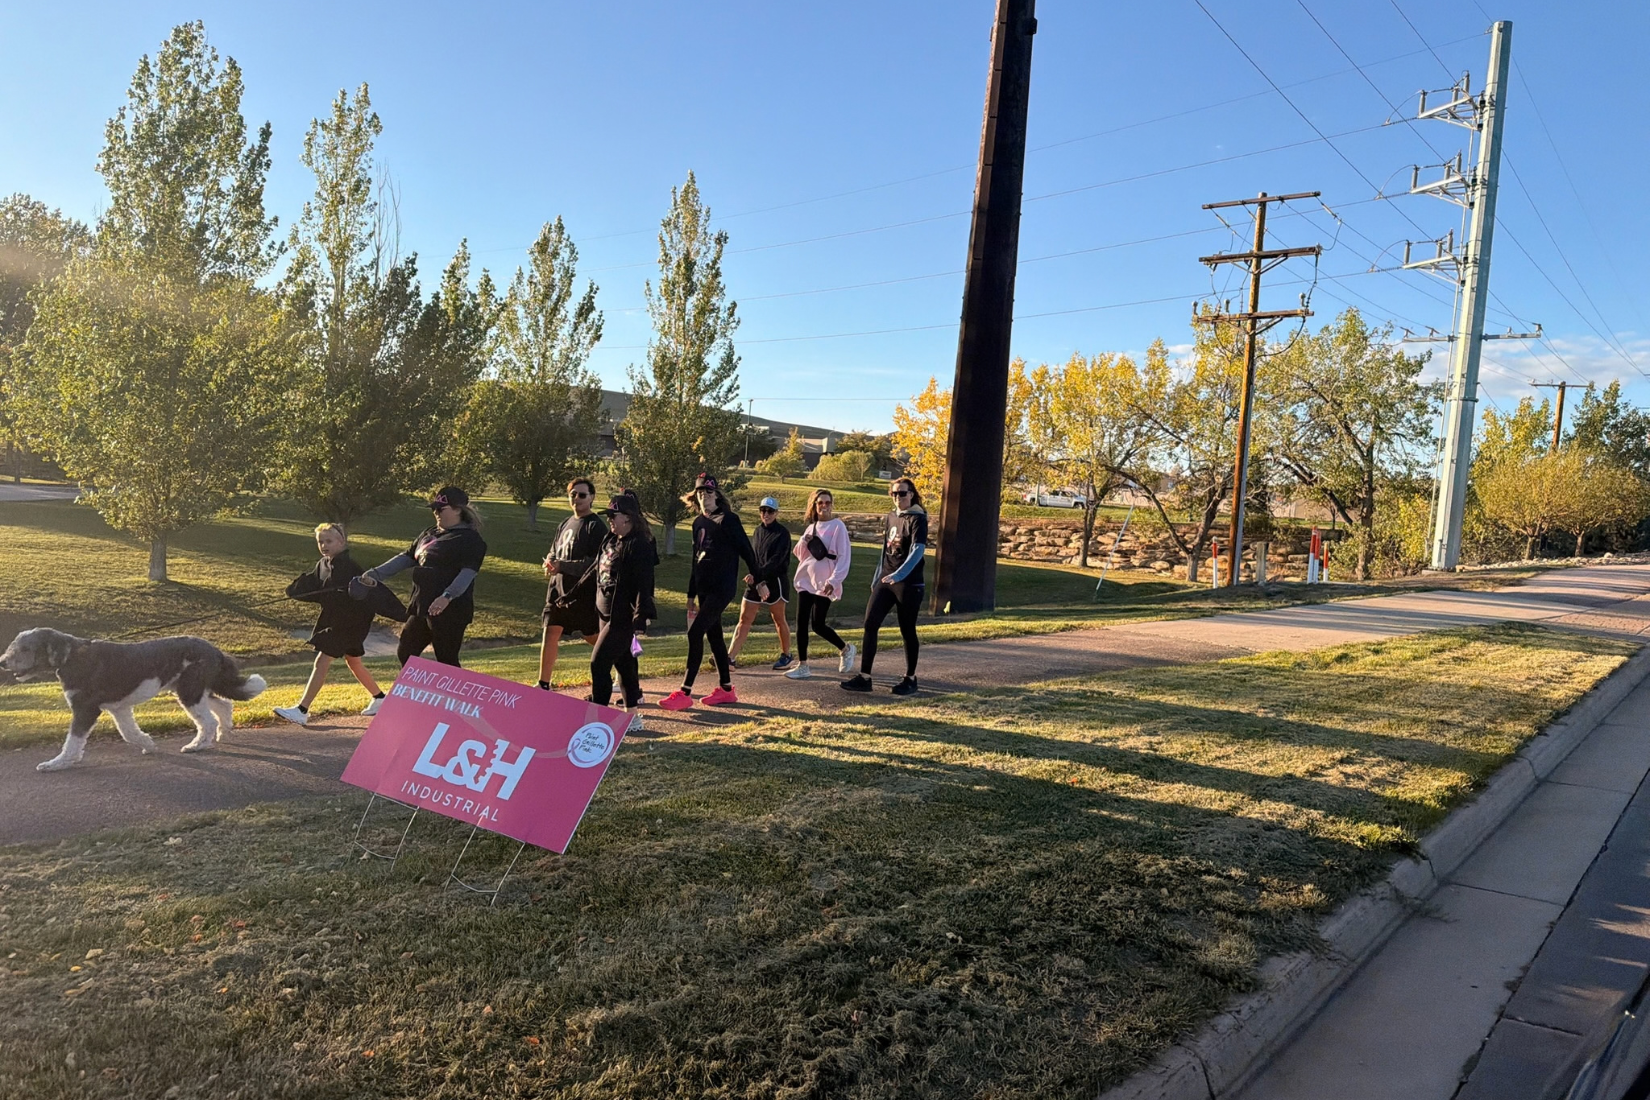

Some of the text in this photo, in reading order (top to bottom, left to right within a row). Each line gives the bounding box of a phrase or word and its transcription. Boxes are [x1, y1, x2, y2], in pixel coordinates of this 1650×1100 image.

[391, 683, 484, 719] BENEFIT WALK
[402, 666, 522, 709] PAINT GILLETTE PINK
[412, 722, 537, 800] L&H
[401, 780, 498, 822] INDUSTRIAL
